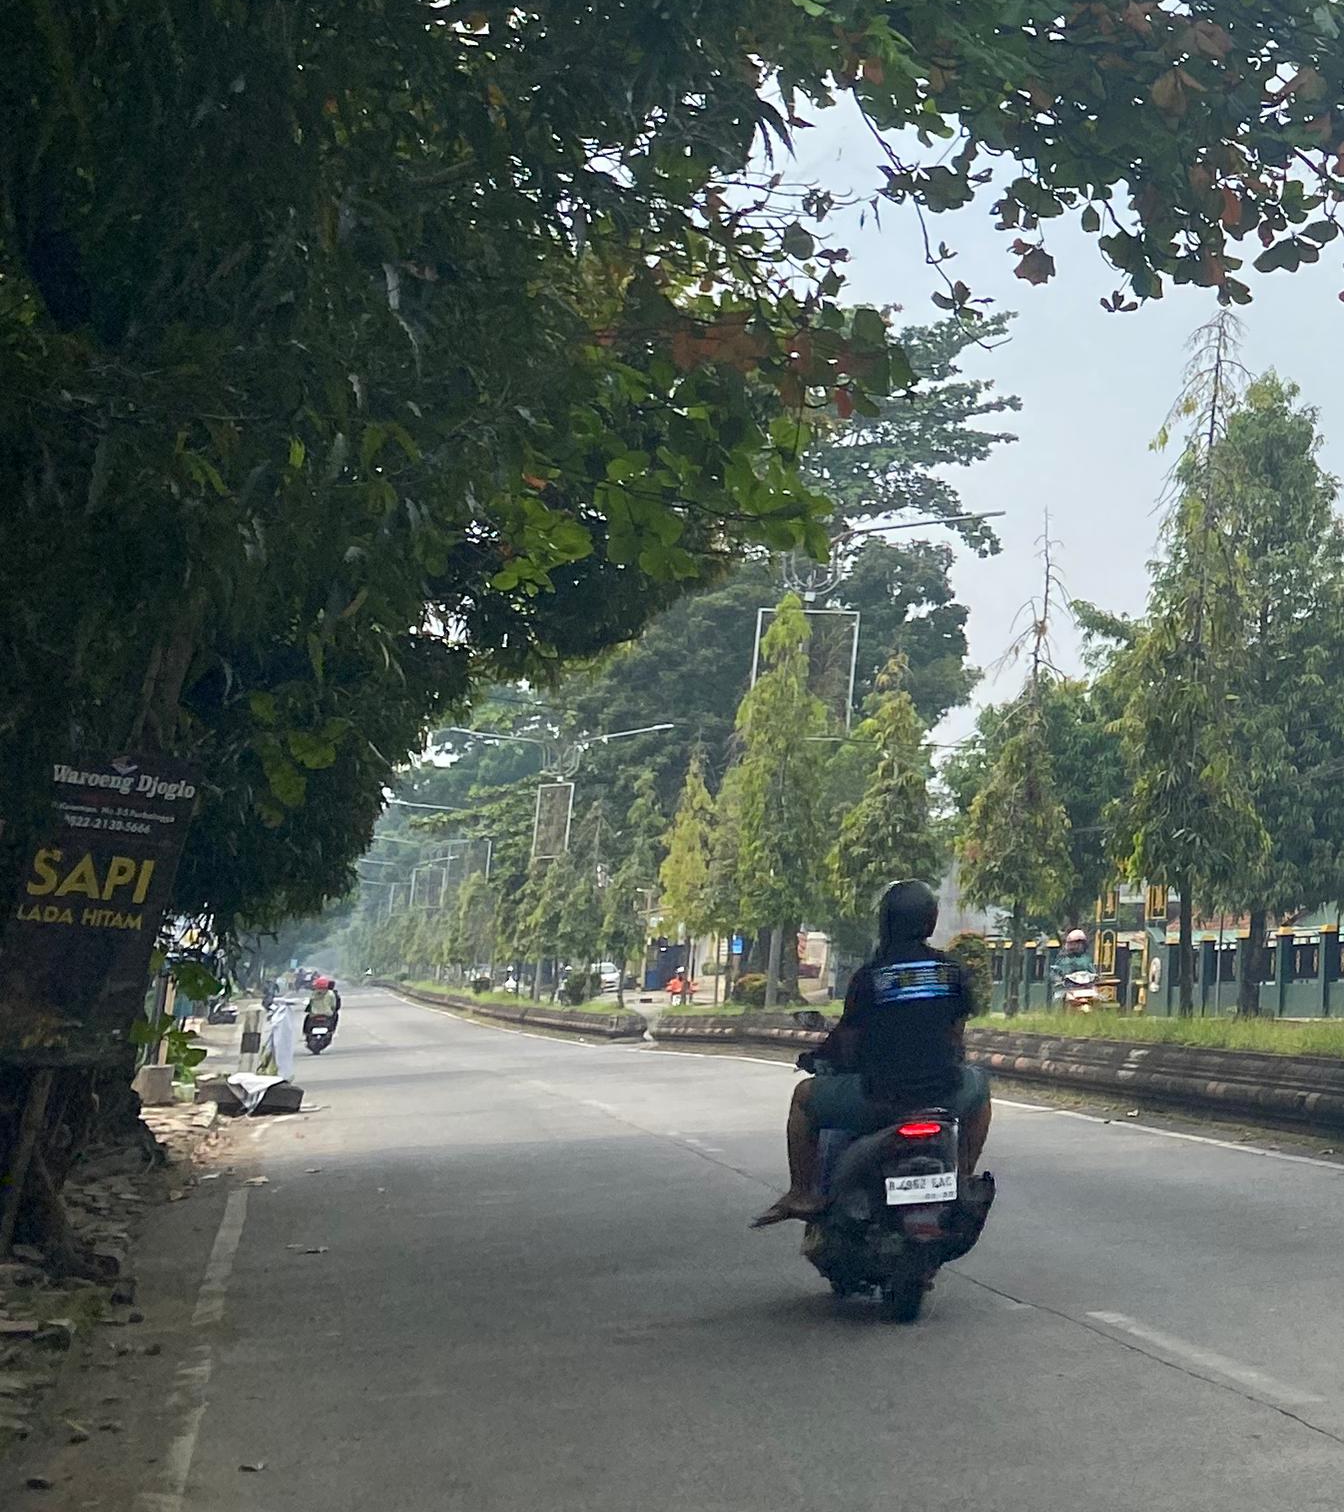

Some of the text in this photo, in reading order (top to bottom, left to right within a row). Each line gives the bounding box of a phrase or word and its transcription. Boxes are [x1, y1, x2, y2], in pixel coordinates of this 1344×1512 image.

[53, 764, 196, 801] Waroeng Djoglo
[27, 847, 156, 904] SAPI
[16, 904, 143, 930] LADA HITAM
